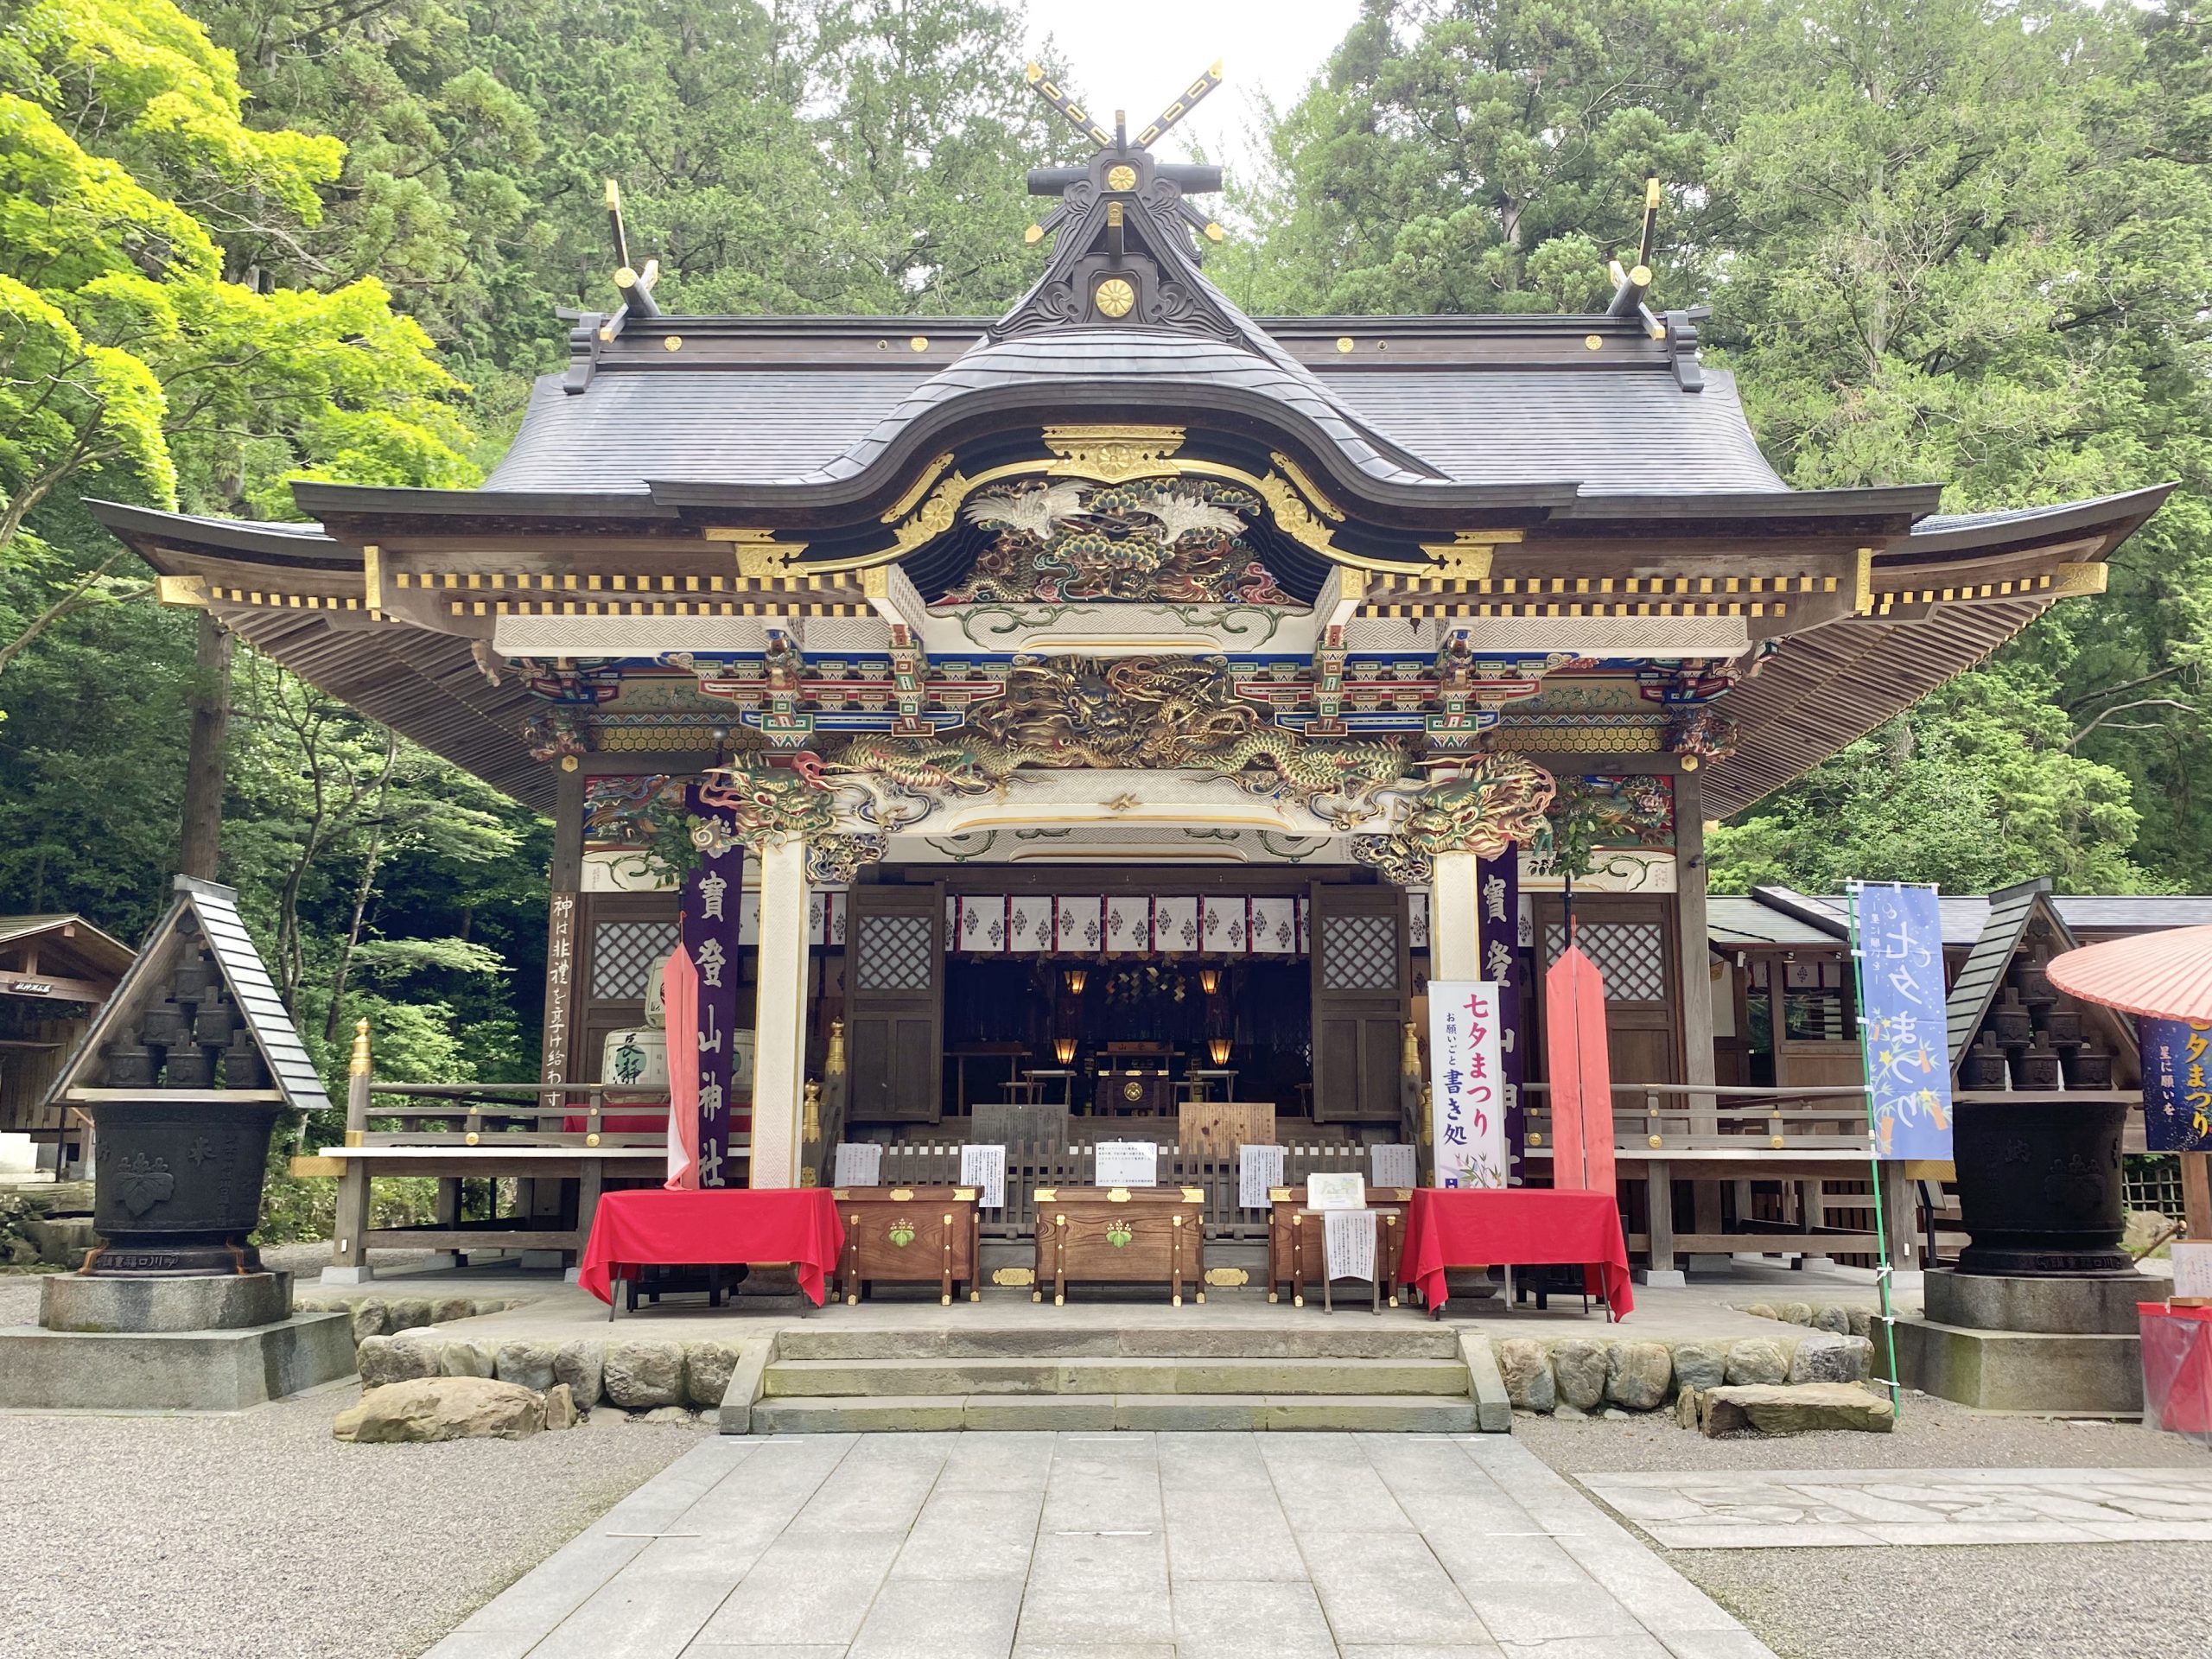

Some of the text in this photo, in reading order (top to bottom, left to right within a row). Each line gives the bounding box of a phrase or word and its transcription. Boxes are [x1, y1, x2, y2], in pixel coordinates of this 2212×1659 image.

[695, 870, 728, 1188] 寶登山神社
[1463, 993, 1492, 1138] 七夕まつり
[2159, 1045, 2176, 1116] 星に願いを
[2184, 1023, 2212, 1139] 夕まつり
